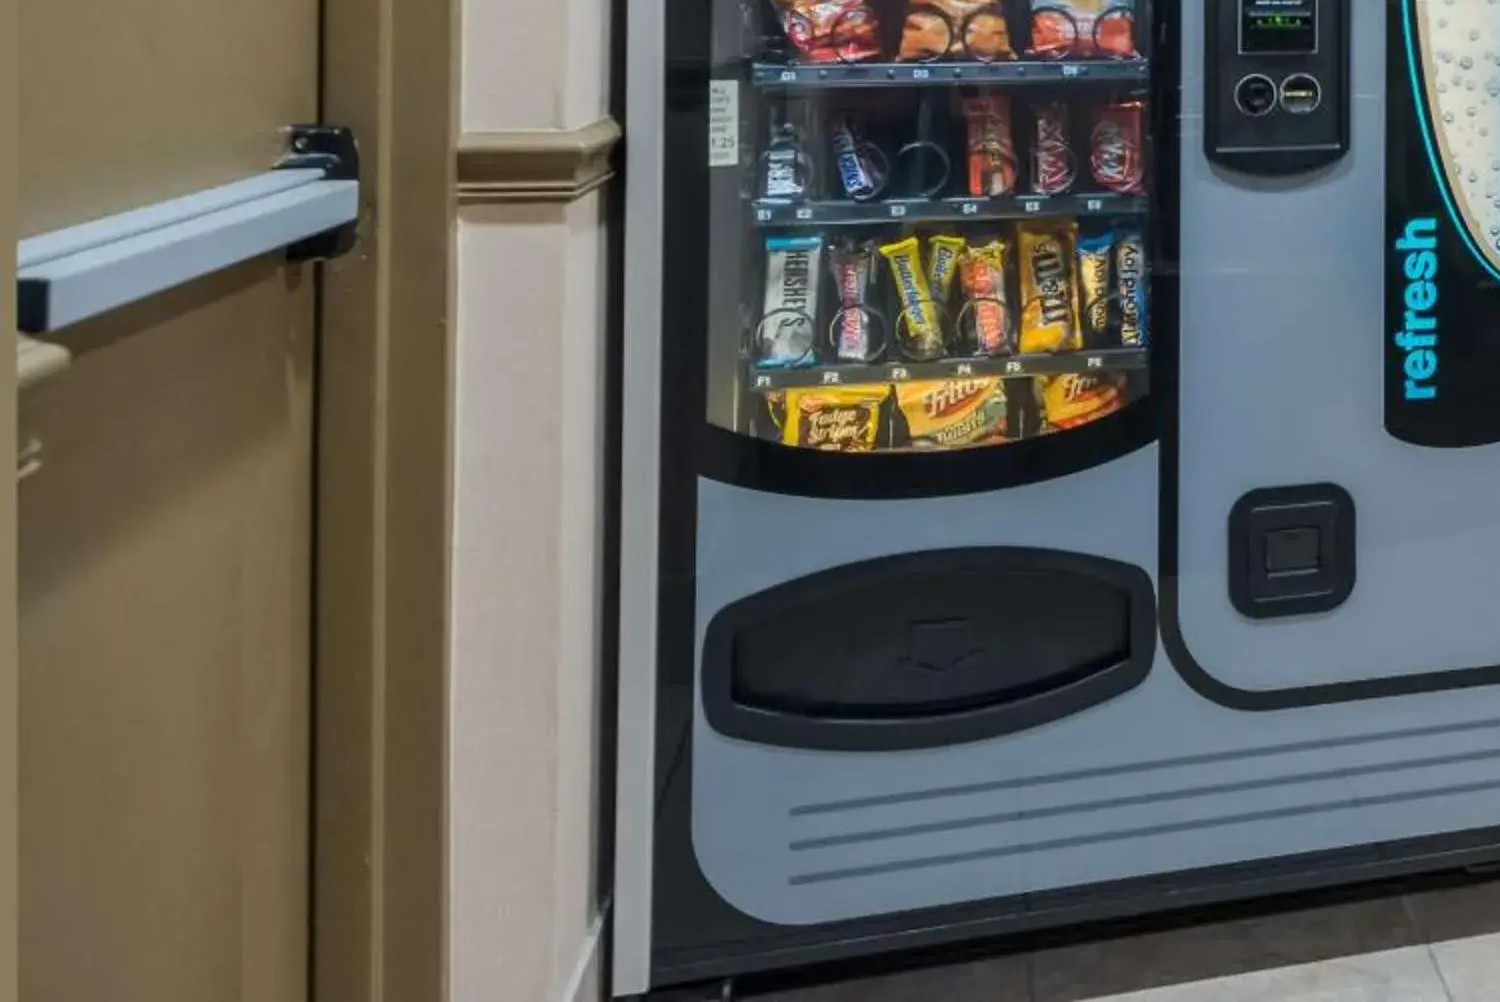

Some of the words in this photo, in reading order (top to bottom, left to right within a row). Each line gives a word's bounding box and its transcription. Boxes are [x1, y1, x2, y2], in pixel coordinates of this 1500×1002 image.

[784, 250, 809, 327] HERSHEYS
[1395, 217, 1439, 400] refresh
[757, 376, 772, 387] F1
